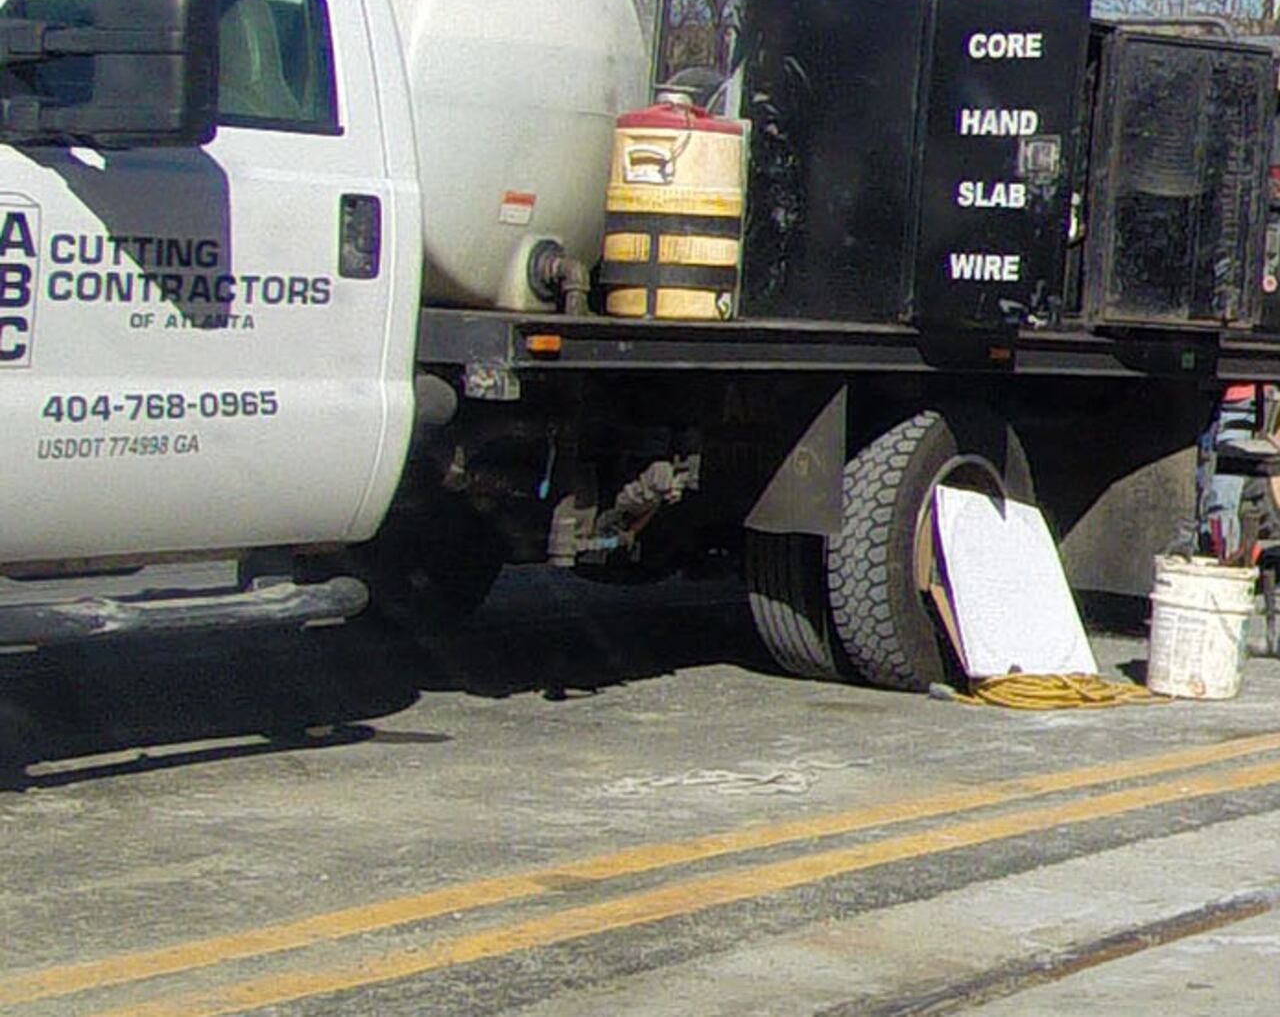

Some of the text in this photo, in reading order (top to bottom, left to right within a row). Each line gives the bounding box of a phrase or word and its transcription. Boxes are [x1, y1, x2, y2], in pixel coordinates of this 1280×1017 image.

[968, 33, 1043, 59] CORE
[960, 109, 1039, 136] HAND
[957, 182, 1027, 209] SLAB
[51, 234, 219, 268] CUTTING
[949, 253, 1020, 282] WIRE
[48, 270, 332, 305] CONTRACTORS
[130, 313, 255, 330] OF ATLANTA
[43, 390, 279, 423] 404-768-0965
[37, 437, 104, 459] USDOT
[173, 433, 200, 454] GA
